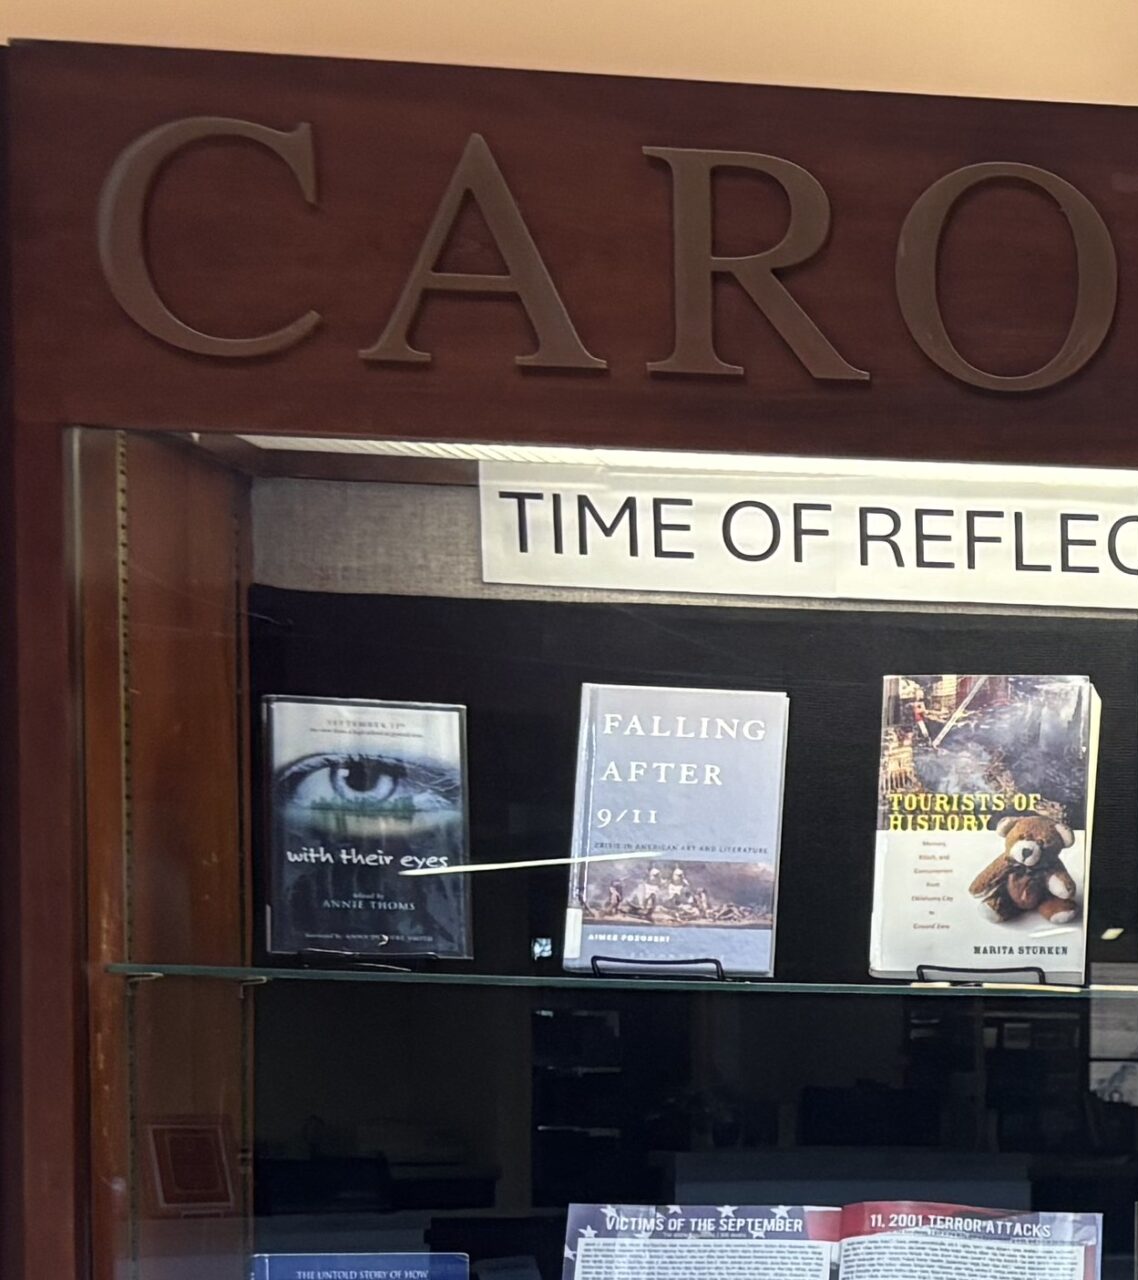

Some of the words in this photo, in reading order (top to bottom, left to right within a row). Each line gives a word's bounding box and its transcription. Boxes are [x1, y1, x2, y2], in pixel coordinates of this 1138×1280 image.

[498, 490, 695, 561] TIME
[720, 499, 831, 565] OF
[603, 713, 767, 741] FALLING
[600, 760, 723, 786] AFTER
[888, 792, 1006, 812] TOURISTS
[1013, 793, 1042, 812] OF
[596, 807, 658, 829] 9/11
[888, 814, 992, 832] HISTORY
[287, 846, 335, 864] with
[339, 848, 395, 866] their
[400, 855, 449, 871] eyes
[322, 900, 365, 910] ANNIE
[369, 900, 416, 911] THOMS
[973, 945, 1015, 955] MARITA
[1018, 945, 1068, 955] STURKEN
[605, 1215, 664, 1231] VICTIMS
[668, 1217, 685, 1232] OF
[689, 1217, 716, 1232] THE
[719, 1217, 804, 1233] SEPTEMBER
[888, 1213, 924, 1228] 2001
[927, 1214, 984, 1231] TERROR
[985, 1220, 1051, 1238] ATTACKS
[296, 1270, 315, 1280] THE
[317, 1270, 357, 1280] UNTOLD
[359, 1270, 387, 1279] STORY
[389, 1270, 402, 1279] OF
[404, 1269, 429, 1279] HOW
